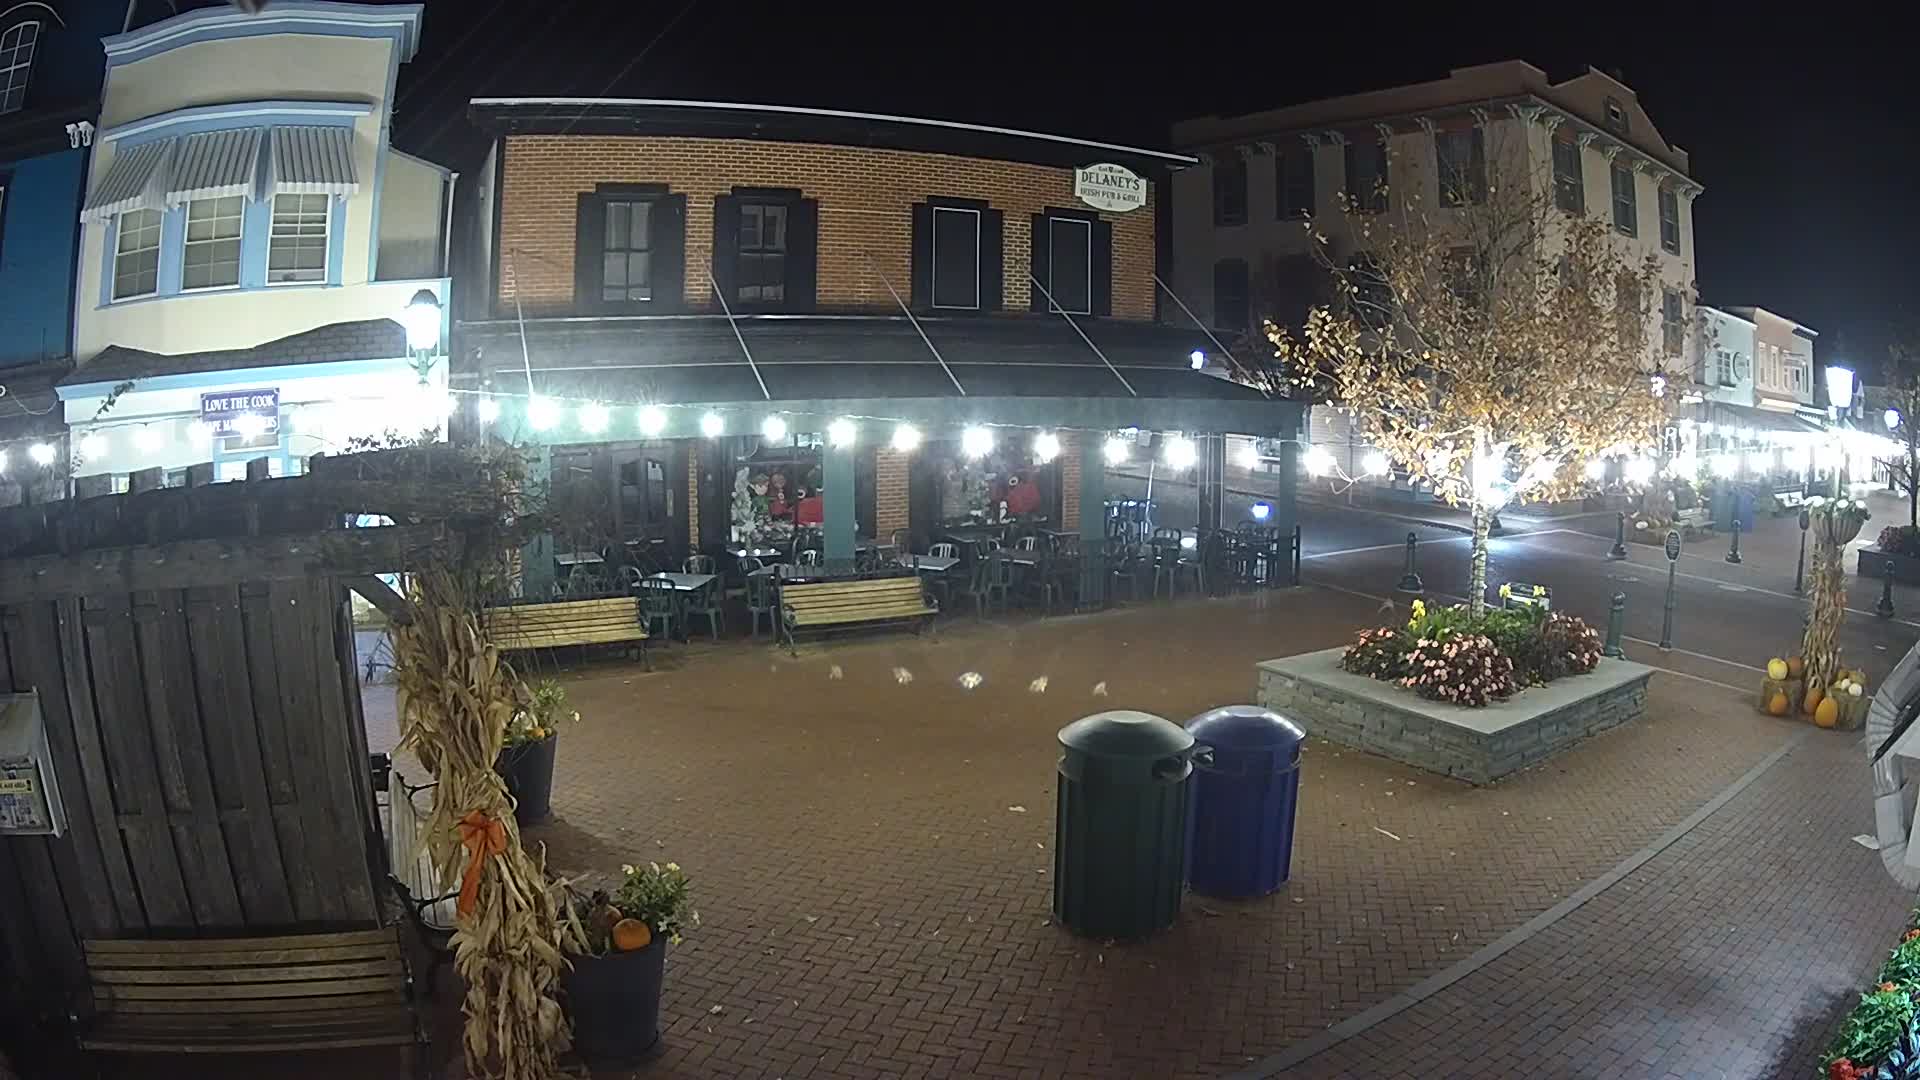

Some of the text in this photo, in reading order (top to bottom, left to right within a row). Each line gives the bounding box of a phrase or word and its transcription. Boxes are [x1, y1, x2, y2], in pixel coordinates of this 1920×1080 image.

[1081, 171, 1140, 191] DELANEY'S
[205, 394, 275, 412] LOVE THE COOK
